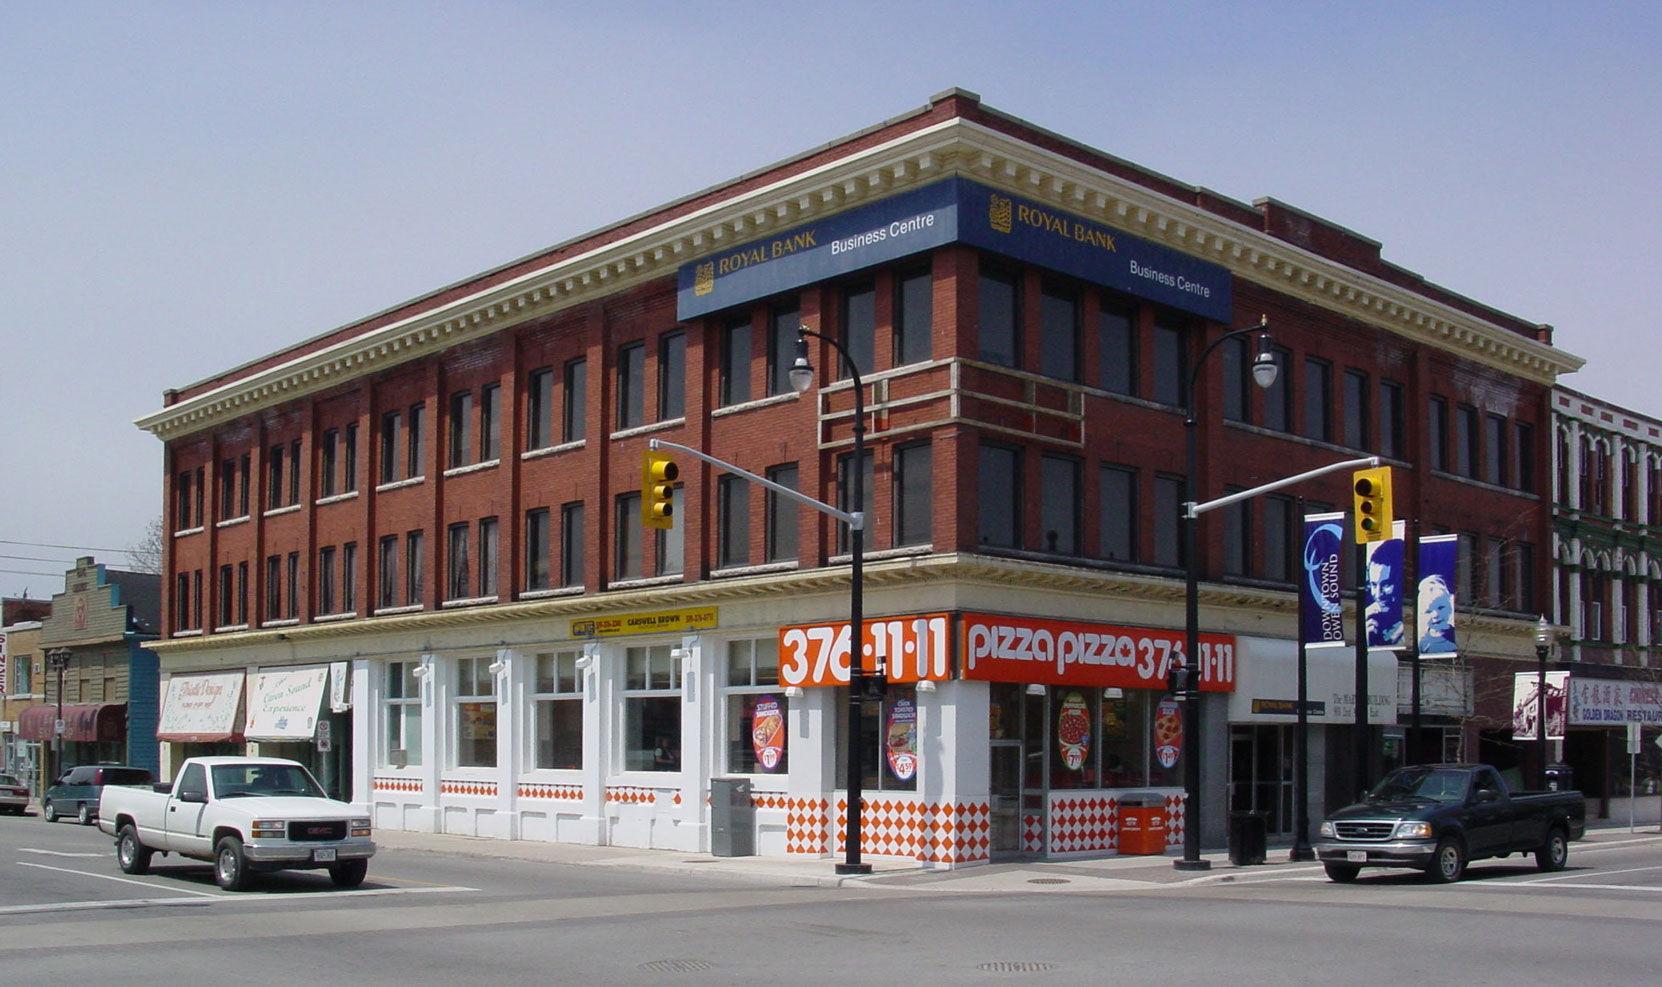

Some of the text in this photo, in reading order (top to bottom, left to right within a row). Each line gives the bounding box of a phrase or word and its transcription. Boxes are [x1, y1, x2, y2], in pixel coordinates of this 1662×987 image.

[831, 214, 935, 255] Business Centre
[1018, 204, 1117, 253] ROYAL BANK
[719, 230, 817, 274] ROYAL BANK
[1130, 260, 1210, 298] Business Centre
[1321, 562, 1333, 640] DOWNTOWN
[1329, 553, 1343, 640] OWEN SOUND
[658, 614, 680, 624] BROWN
[968, 623, 1054, 670] pizza
[1582, 707, 1602, 720] GOLDEN
[1603, 708, 1624, 721] DRAGON
